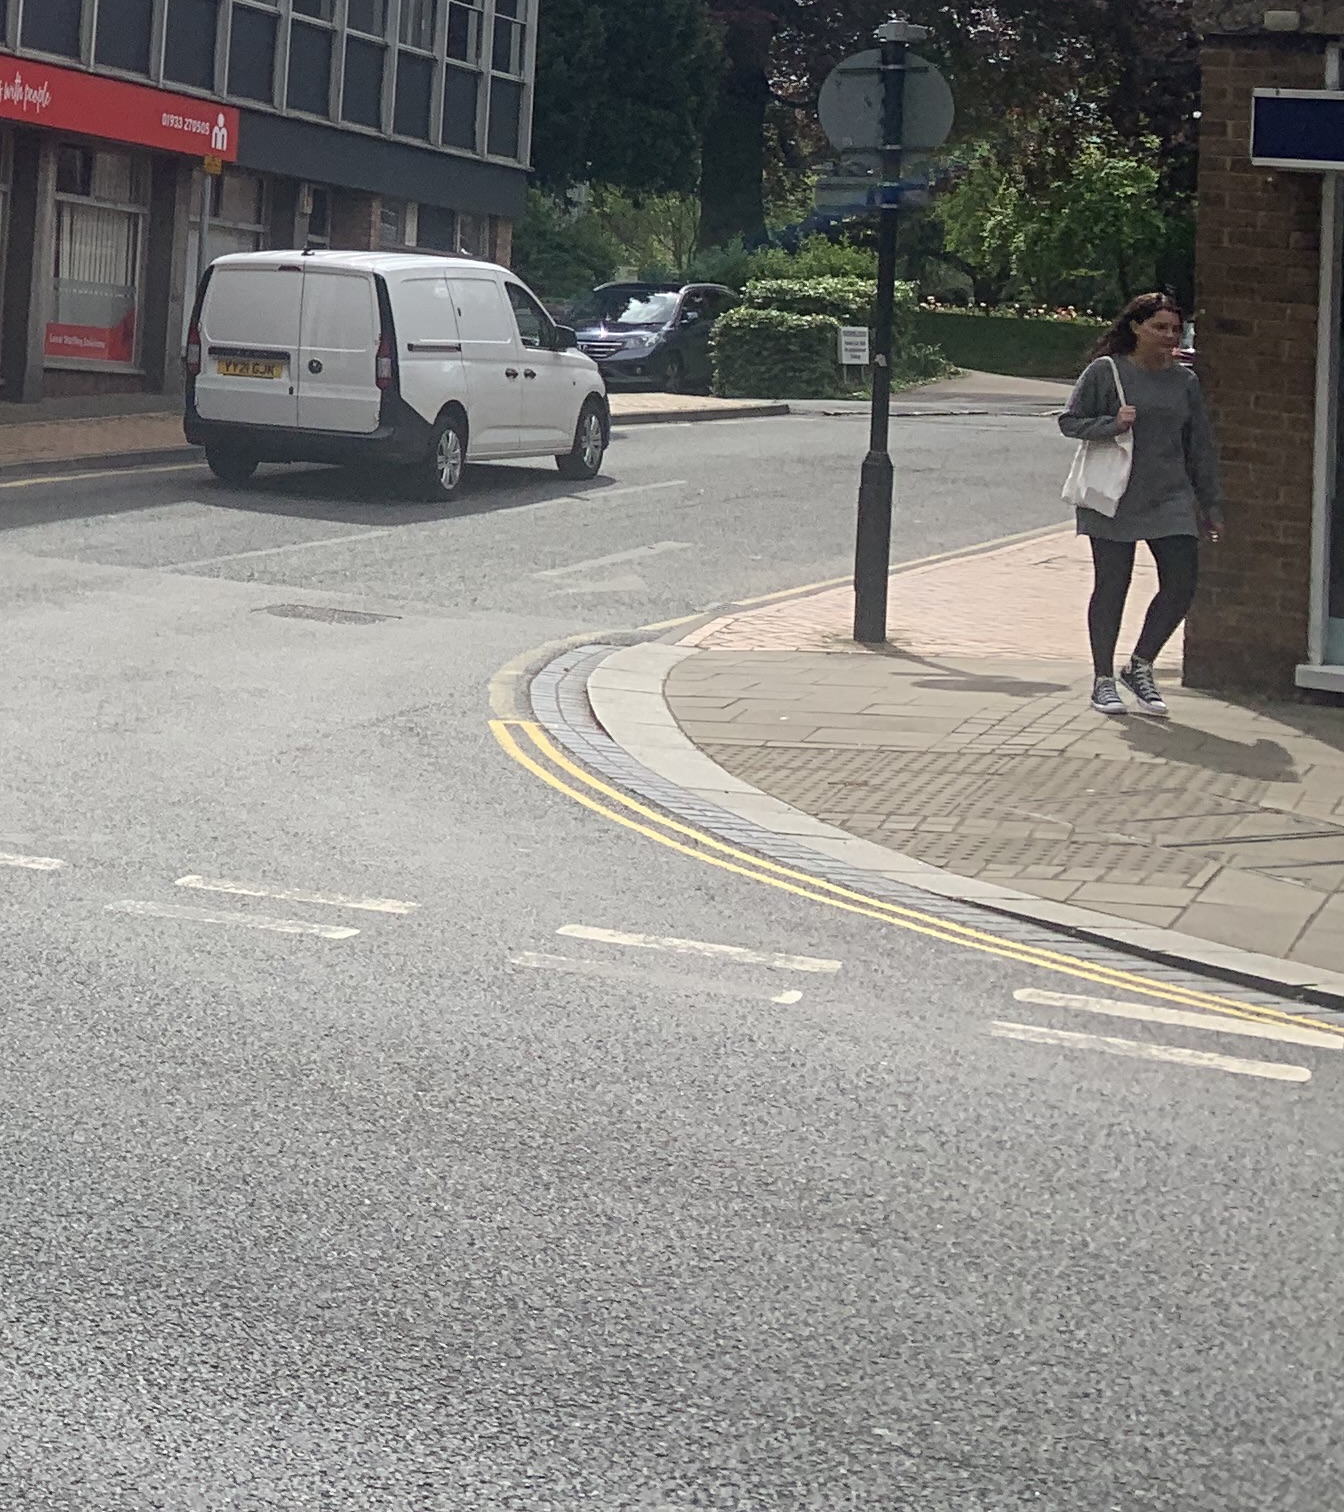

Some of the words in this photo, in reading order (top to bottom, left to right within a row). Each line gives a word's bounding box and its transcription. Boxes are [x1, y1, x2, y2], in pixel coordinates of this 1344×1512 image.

[4, 70, 24, 106] with
[23, 80, 51, 114] people
[161, 112, 183, 129] 01933
[183, 117, 211, 136] 270505
